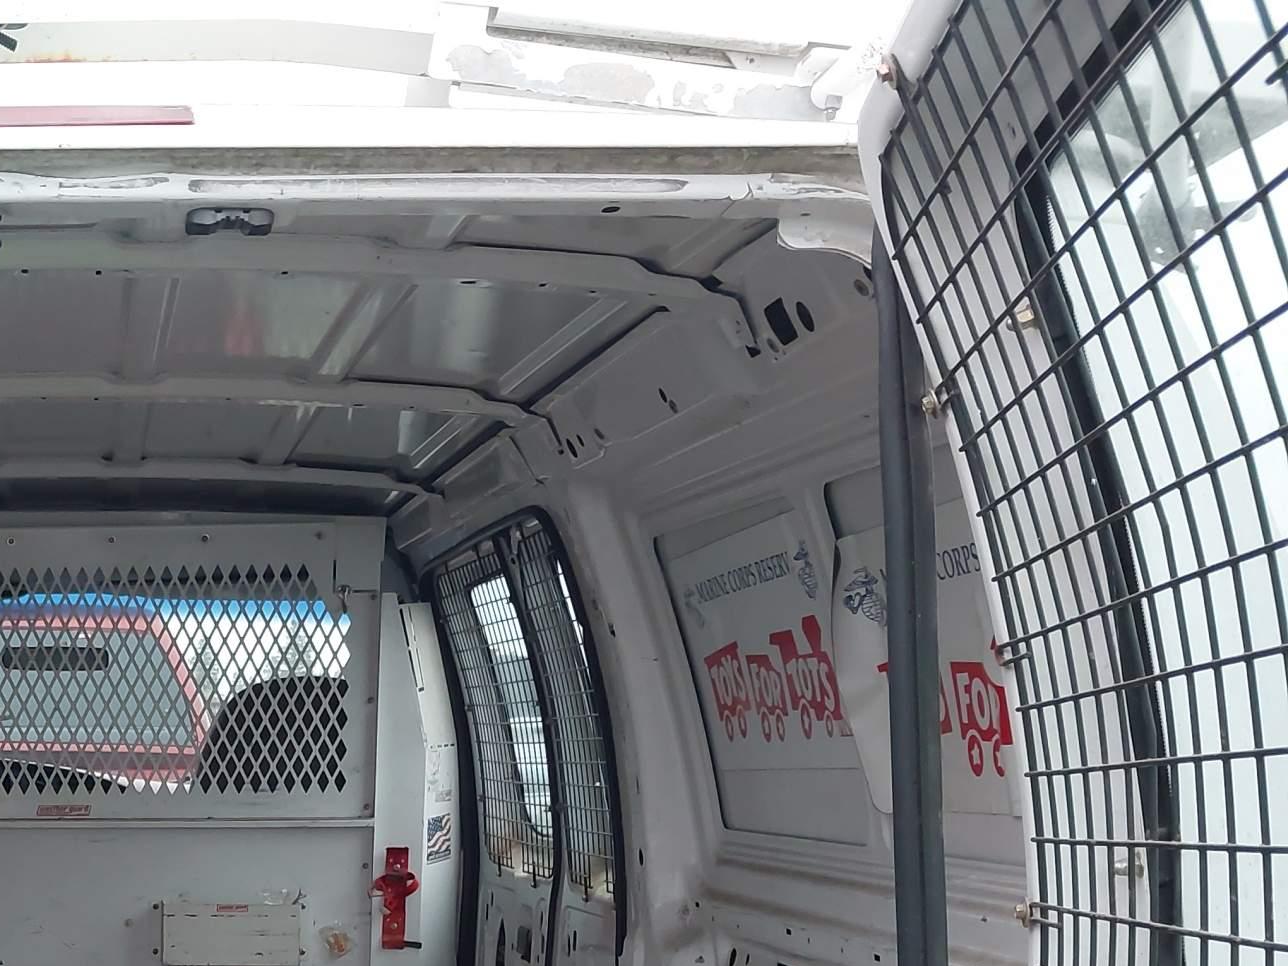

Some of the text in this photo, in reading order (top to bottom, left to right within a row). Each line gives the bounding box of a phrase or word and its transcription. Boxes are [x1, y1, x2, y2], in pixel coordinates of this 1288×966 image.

[711, 655, 836, 713] TOYS FOR TOTS
